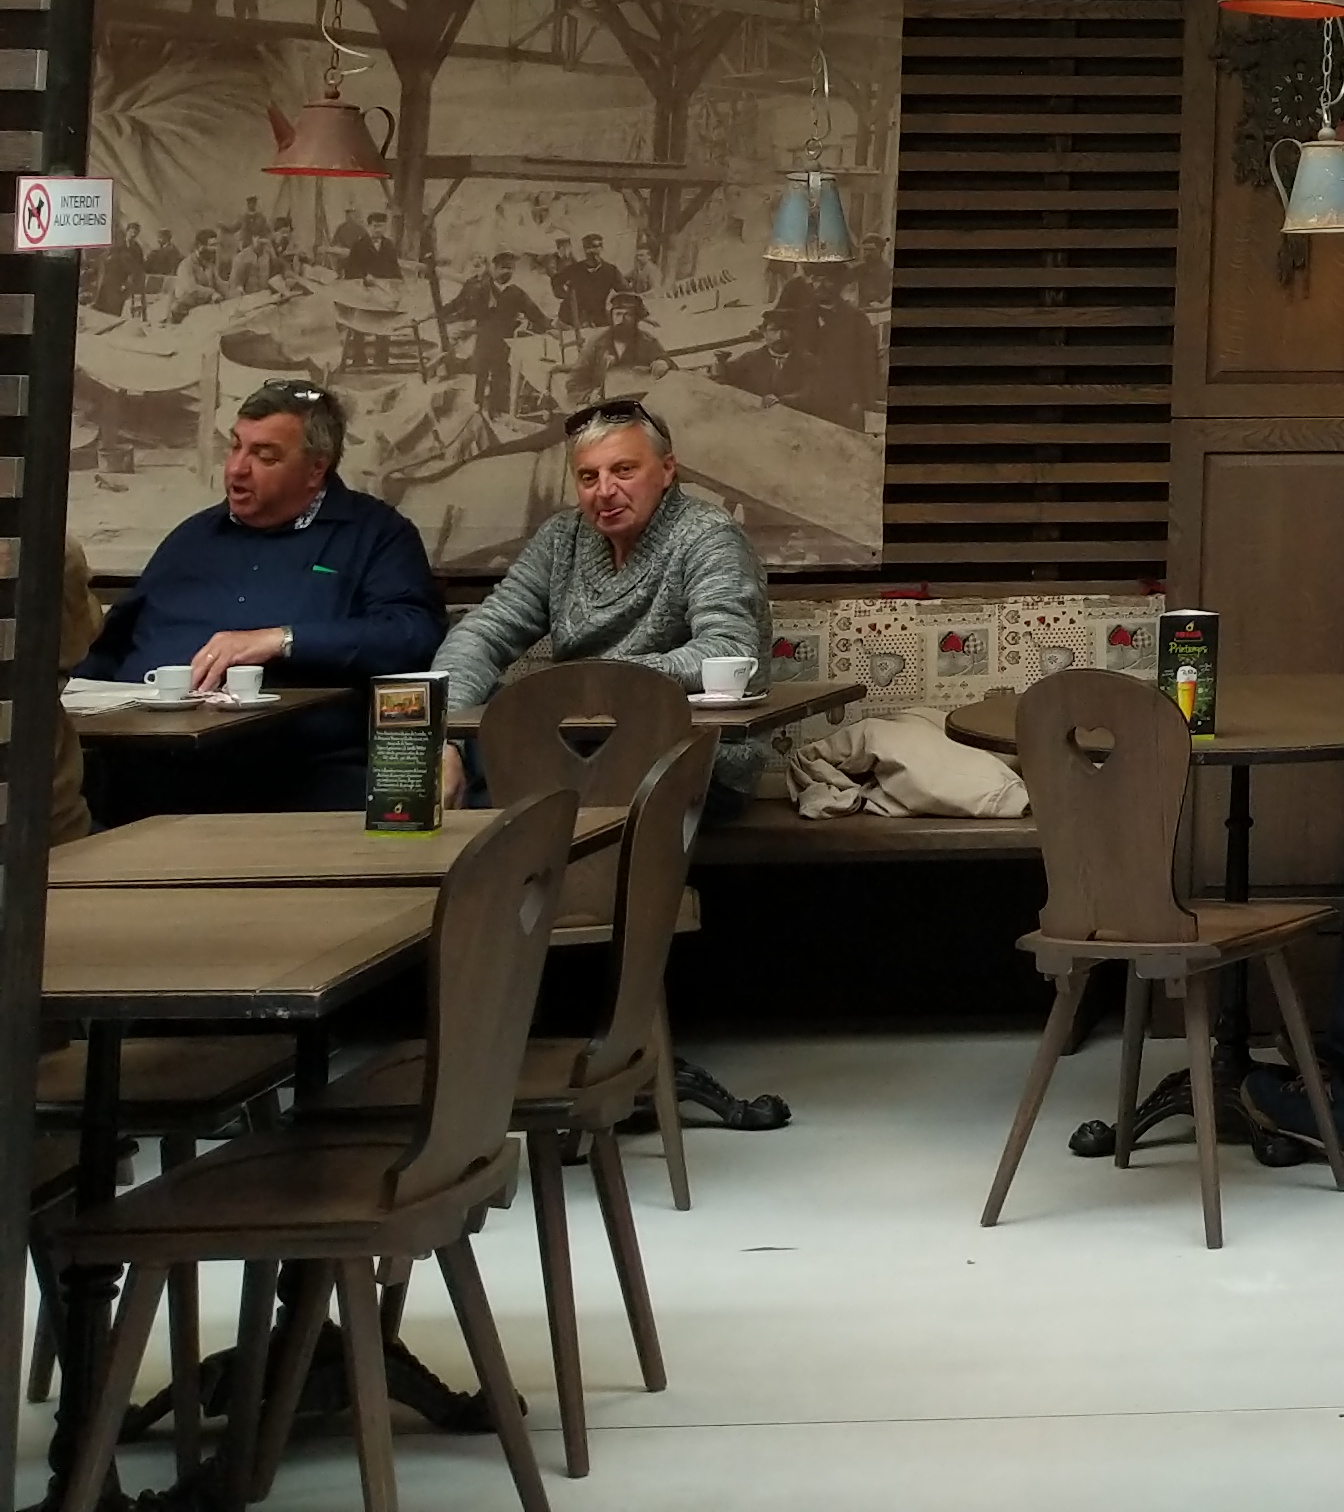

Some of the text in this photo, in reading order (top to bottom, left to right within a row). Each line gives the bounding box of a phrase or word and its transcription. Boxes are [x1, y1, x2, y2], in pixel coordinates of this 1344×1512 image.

[60, 195, 102, 208] INTERDIT
[53, 213, 107, 226] AUX CHIENS
